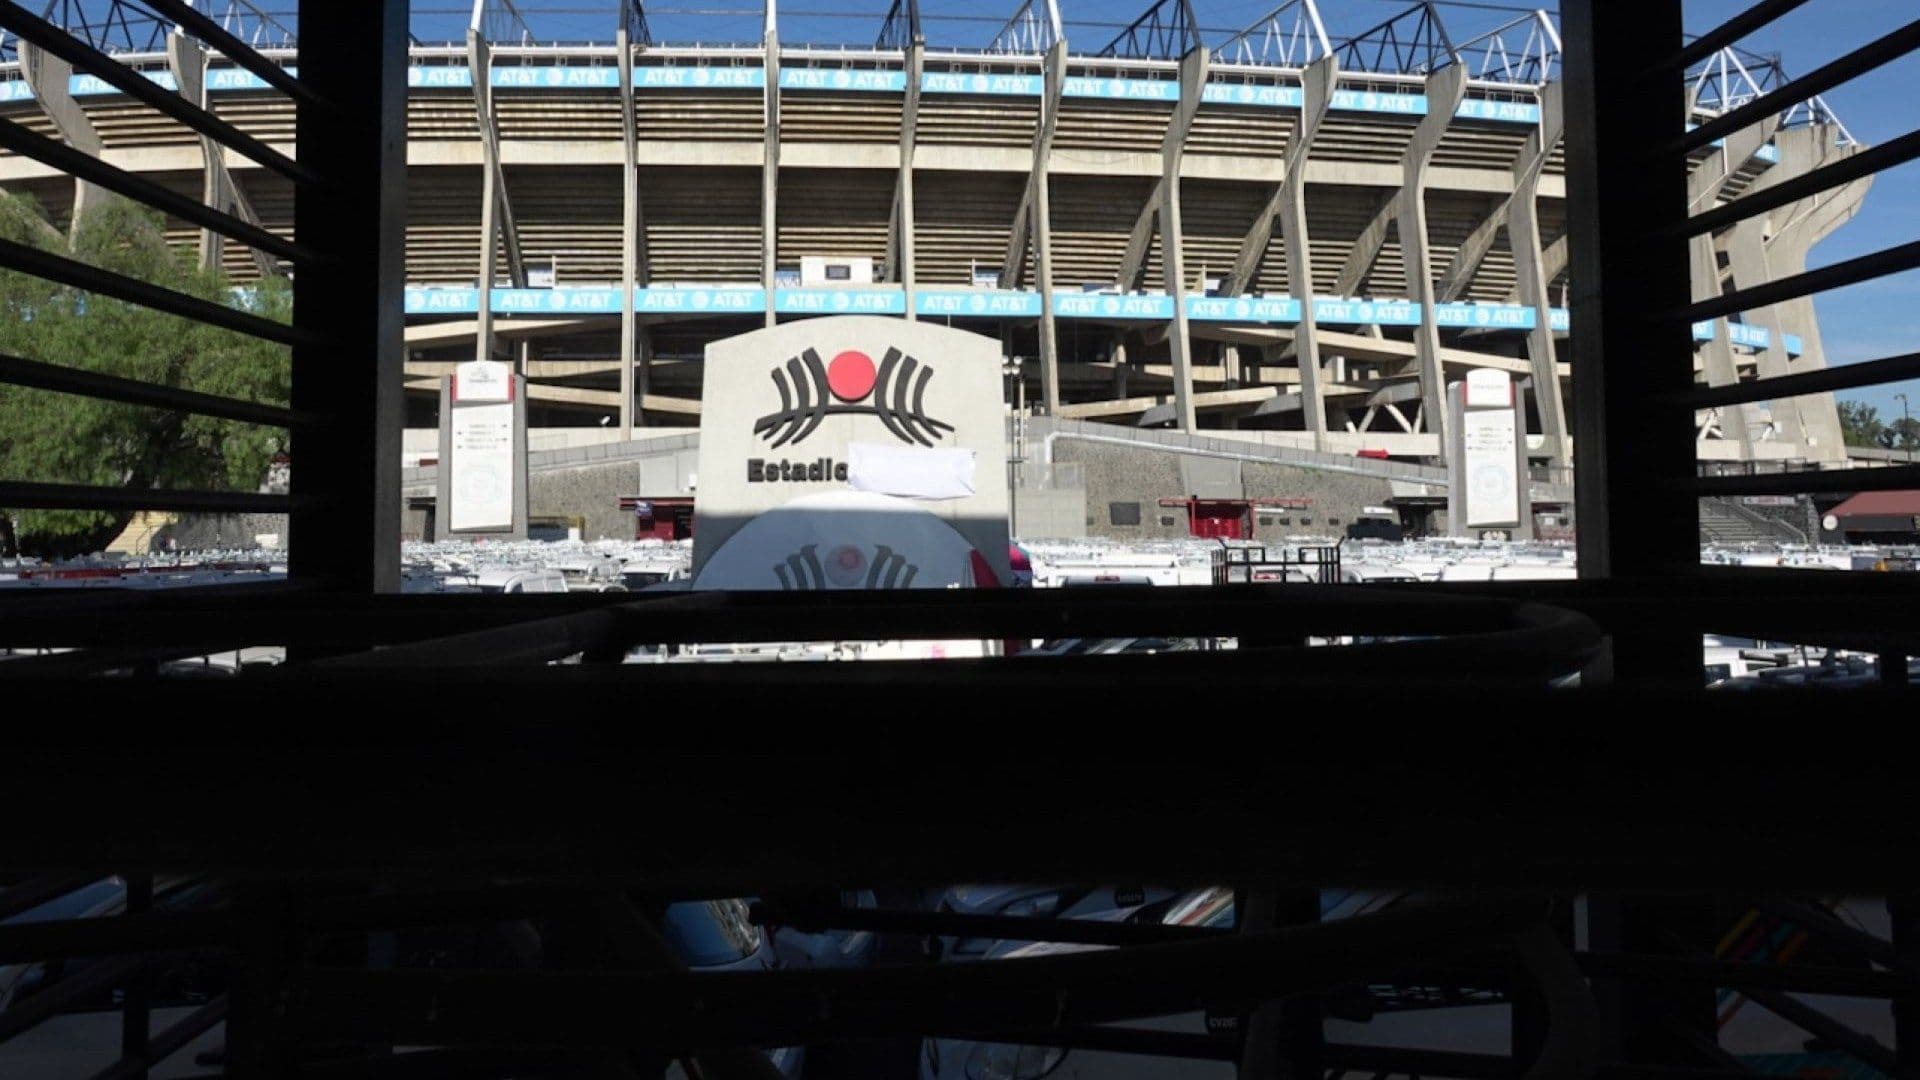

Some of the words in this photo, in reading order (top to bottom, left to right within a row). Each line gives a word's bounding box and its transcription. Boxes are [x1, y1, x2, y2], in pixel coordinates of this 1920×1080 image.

[427, 70, 465, 83] AT&T
[500, 69, 538, 83] AT&T
[567, 69, 608, 83] AT&T
[644, 69, 686, 83] AT&T
[713, 70, 753, 84] AT&T
[786, 70, 827, 84] AT&T
[855, 72, 895, 86] AT&T
[927, 75, 965, 91] AT&T
[993, 77, 1033, 92] AT&T
[1065, 78, 1104, 93] AT&T
[1129, 80, 1168, 96] AT&T
[1255, 88, 1294, 103] AT&T
[1382, 94, 1416, 110] AT&T
[1500, 102, 1533, 118] AT&T
[431, 291, 469, 307] AT&T
[501, 292, 541, 308] AT&T
[571, 292, 612, 308] AT&T
[646, 291, 687, 307] AT&T
[714, 291, 755, 307] AT&T
[787, 292, 826, 308] AT&T
[855, 292, 895, 308] AT&T
[923, 294, 964, 310] AT&T
[991, 294, 1032, 310] AT&T
[1060, 297, 1098, 313] AT&T
[1124, 297, 1162, 313] AT&T
[1192, 299, 1230, 315] AT&T
[1254, 300, 1291, 316] AT&T
[1317, 303, 1353, 319] AT&T
[1376, 304, 1413, 321] AT&T
[1439, 305, 1473, 322] AT&T
[1493, 307, 1526, 324] AT&T
[747, 457, 850, 483] Estadio
